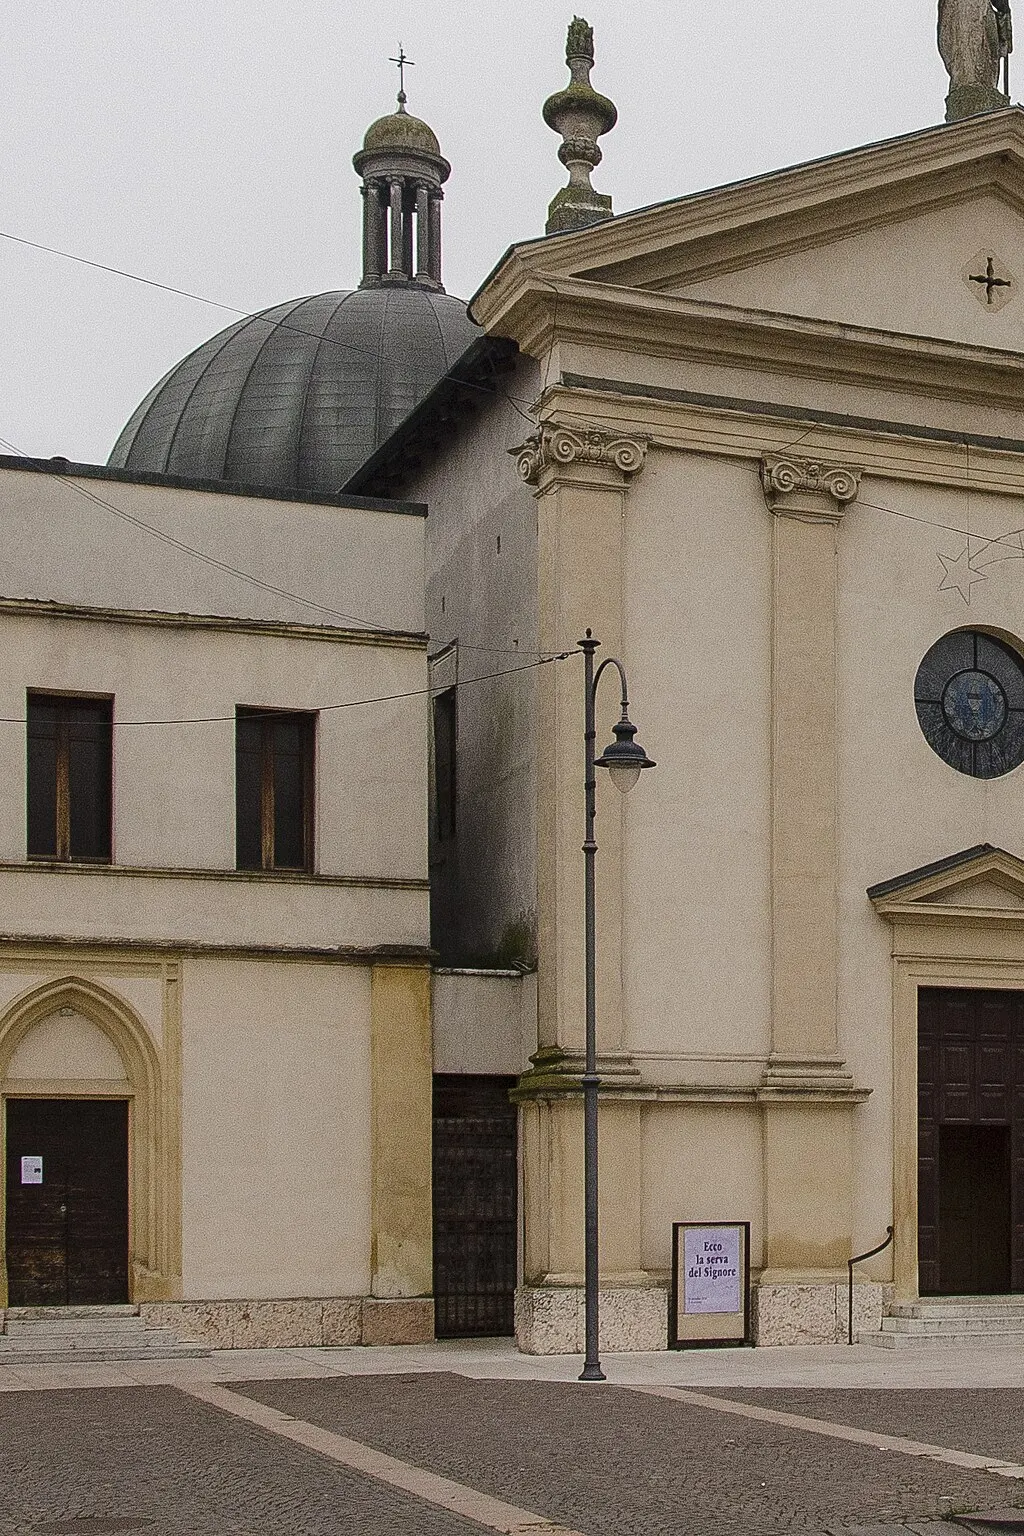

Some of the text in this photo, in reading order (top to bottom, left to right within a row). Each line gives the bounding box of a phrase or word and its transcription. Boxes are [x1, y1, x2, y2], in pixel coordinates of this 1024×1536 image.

[704, 1241, 722, 1251] Ecco
[696, 1255, 728, 1264] la serva
[689, 1266, 736, 1280] del Signore
